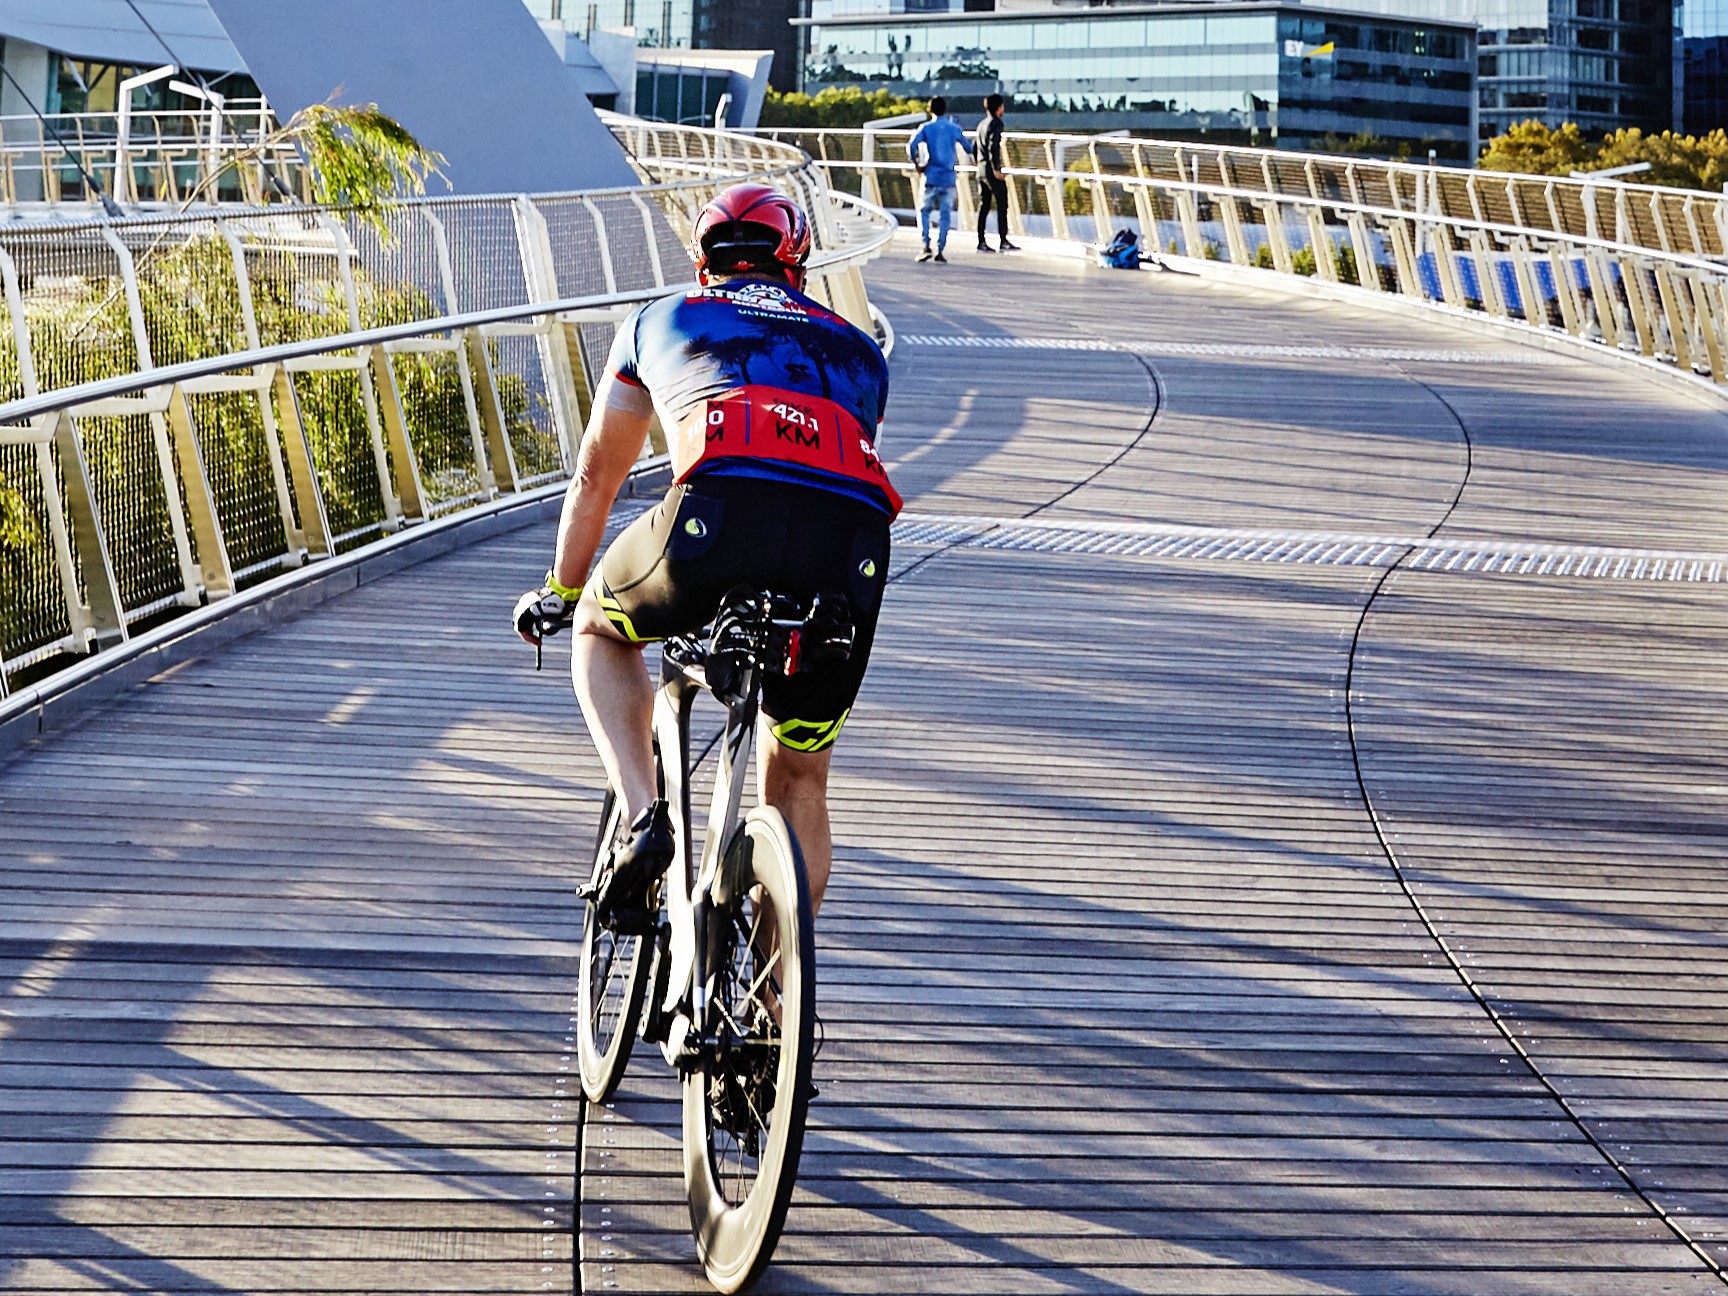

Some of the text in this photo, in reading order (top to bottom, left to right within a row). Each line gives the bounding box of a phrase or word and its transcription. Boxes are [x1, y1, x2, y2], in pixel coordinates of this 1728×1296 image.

[1284, 39, 1304, 58] EY
[773, 403, 819, 432] 421.1
[775, 419, 821, 450] KM
